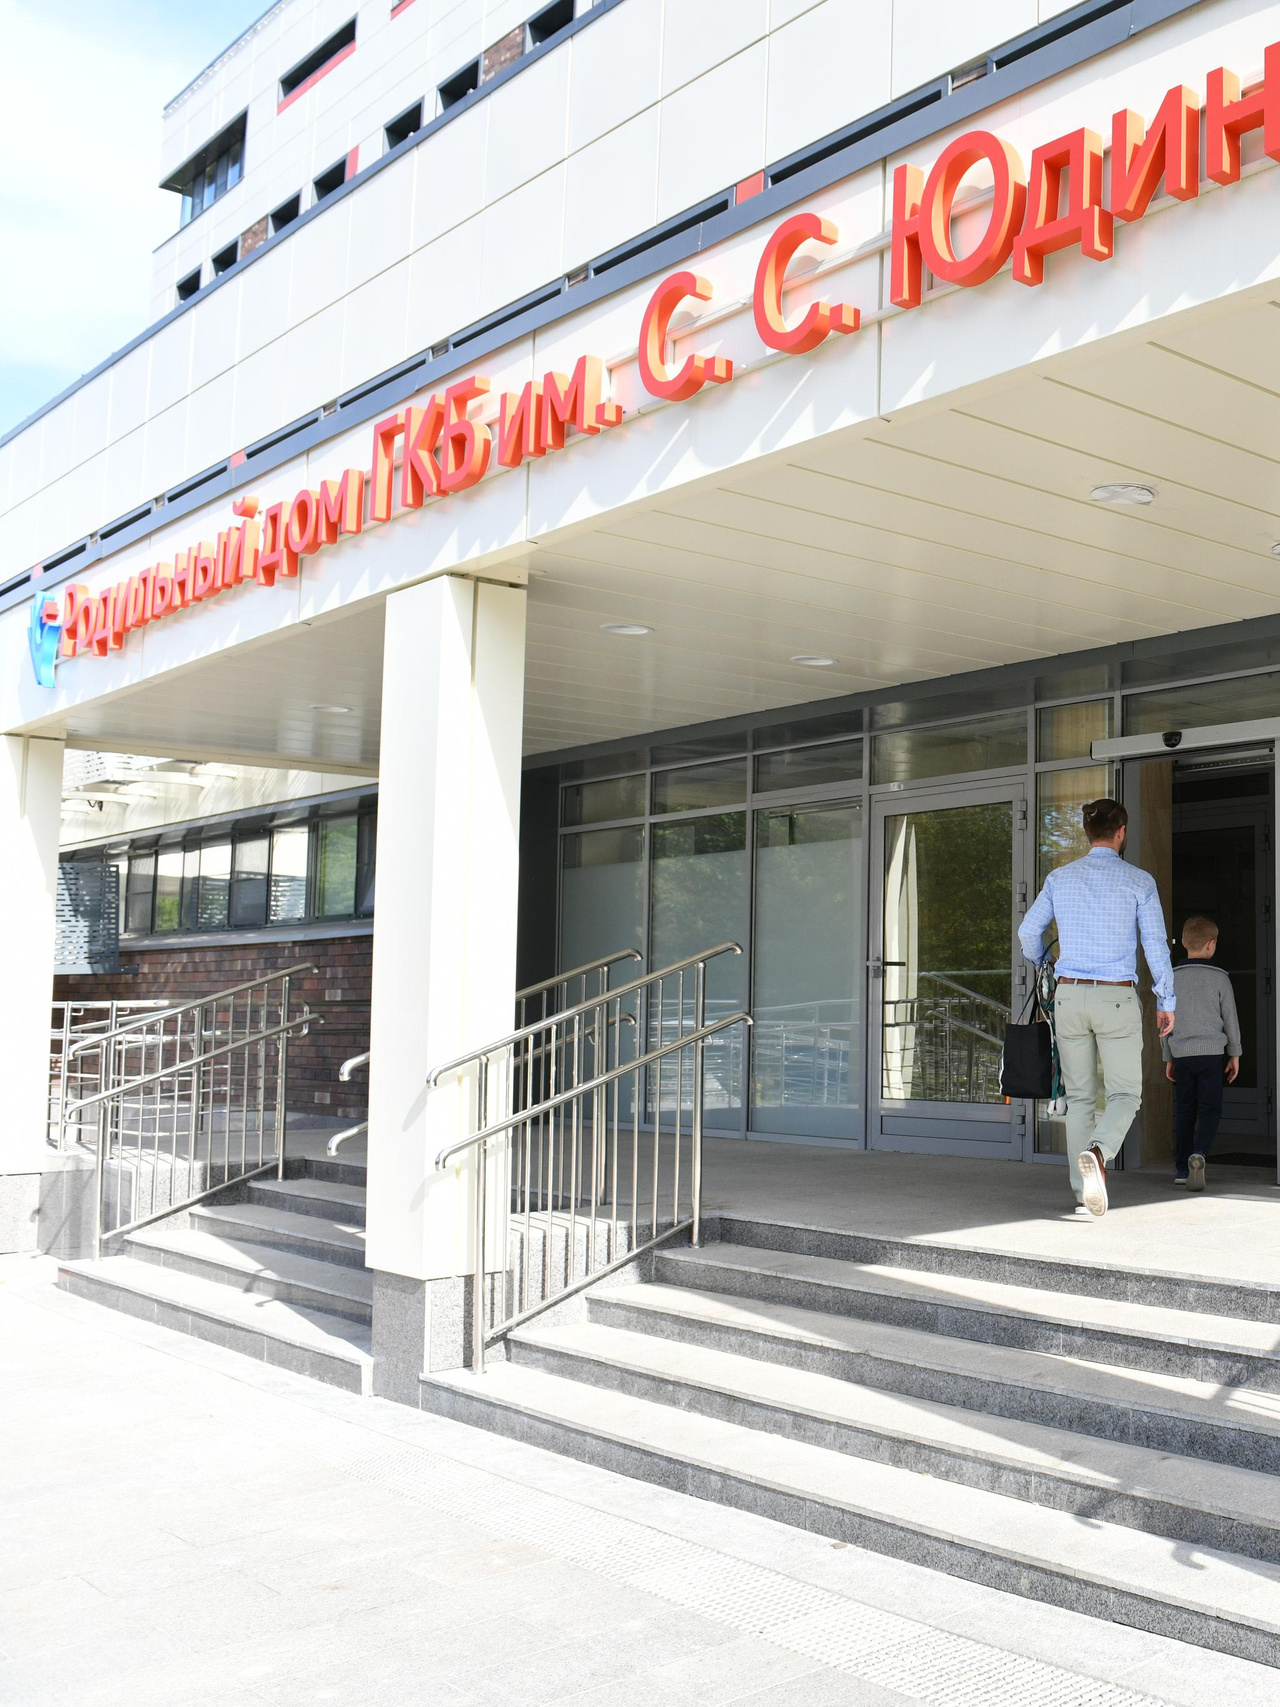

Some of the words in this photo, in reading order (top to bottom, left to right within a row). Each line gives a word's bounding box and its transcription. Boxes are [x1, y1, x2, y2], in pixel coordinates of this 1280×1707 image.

[61, 496, 260, 657] Родильный
[256, 469, 364, 587] дом
[369, 374, 491, 521] ГКБ
[498, 355, 622, 468] им.
[638, 271, 733, 401] С.
[753, 212, 860, 355] С.
